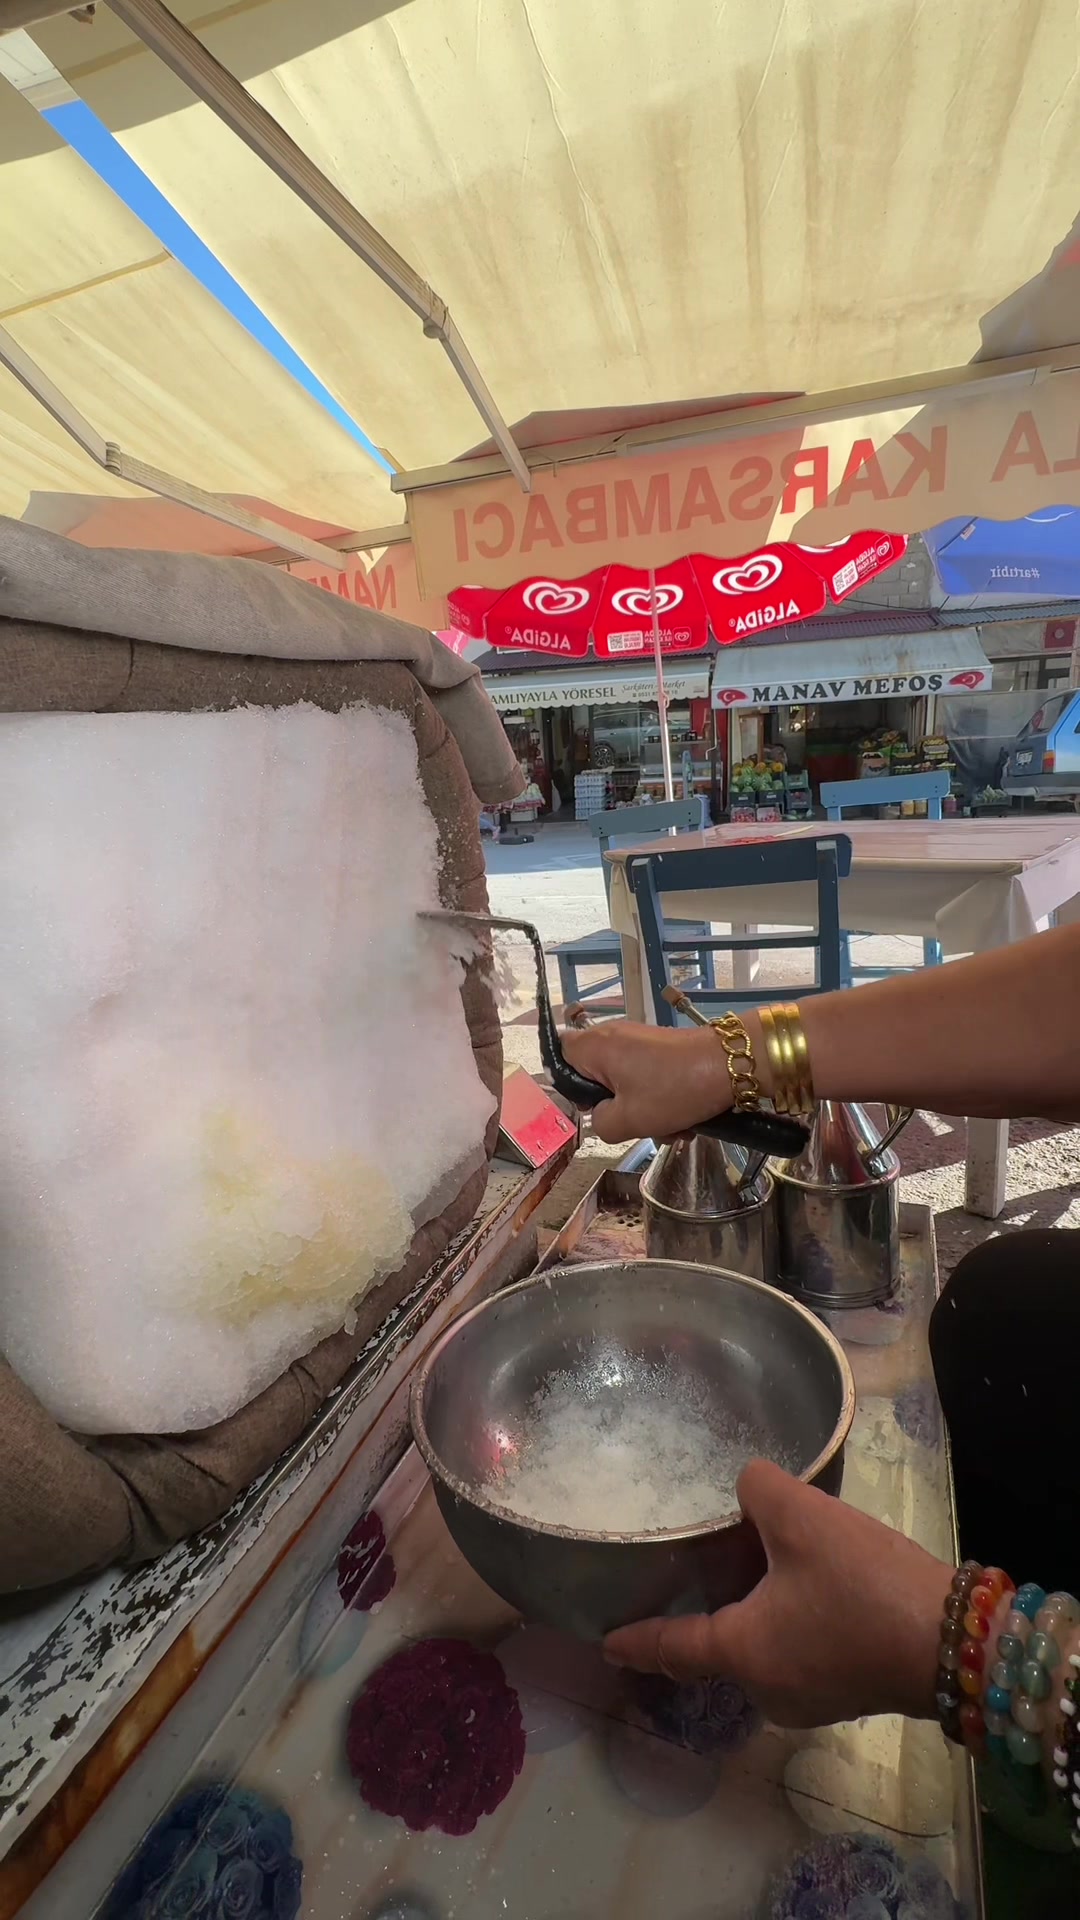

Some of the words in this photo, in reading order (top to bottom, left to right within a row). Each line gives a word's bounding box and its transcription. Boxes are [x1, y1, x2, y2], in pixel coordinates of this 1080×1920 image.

[561, 687, 617, 700] YÖRESEL
[752, 681, 846, 702] MANAV
[852, 674, 943, 696] MEFOŞ
